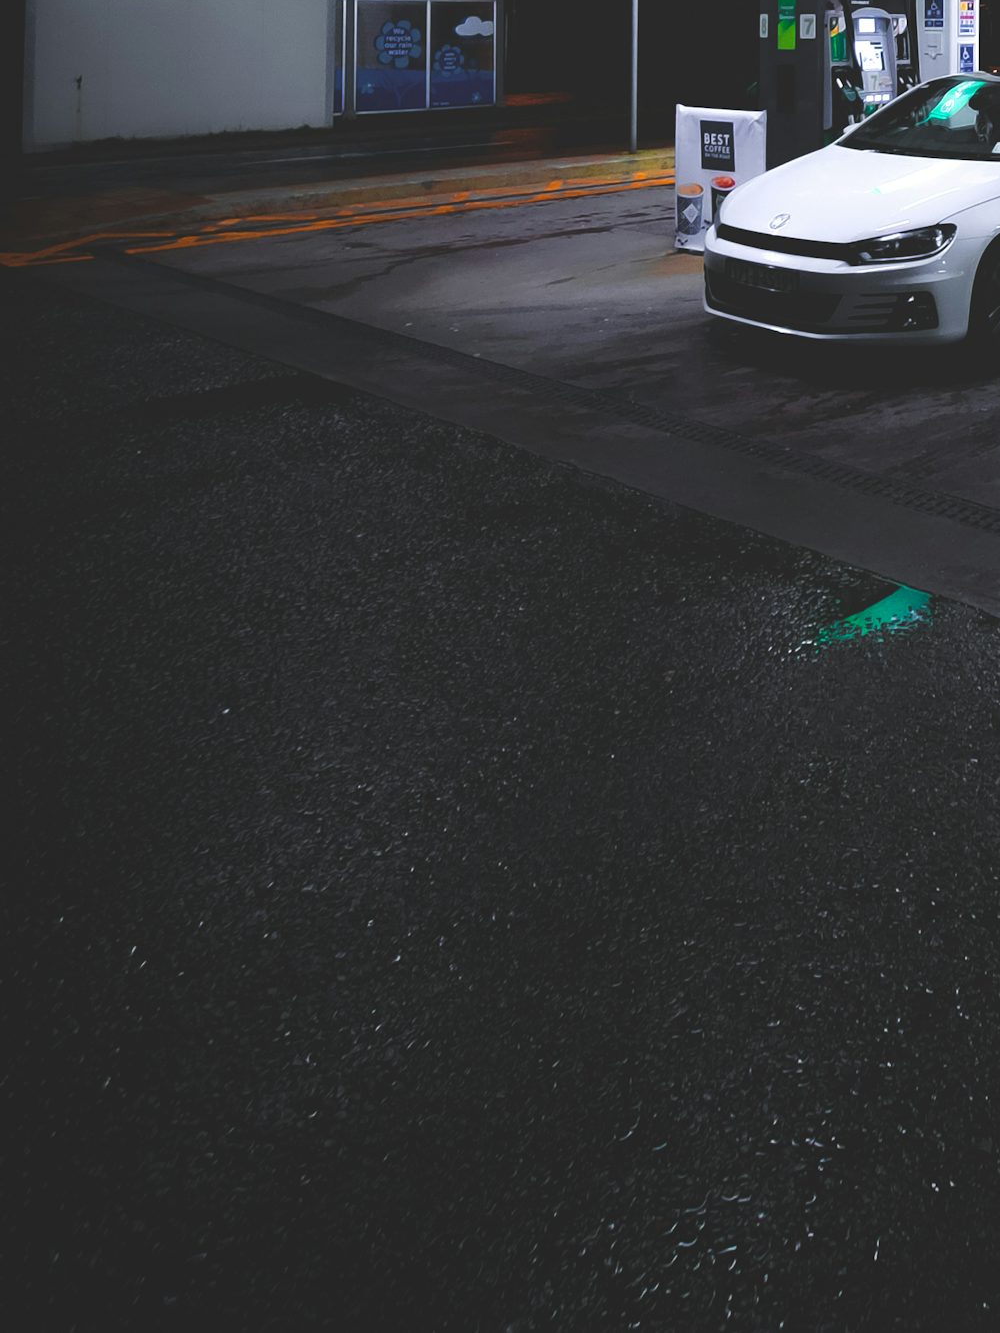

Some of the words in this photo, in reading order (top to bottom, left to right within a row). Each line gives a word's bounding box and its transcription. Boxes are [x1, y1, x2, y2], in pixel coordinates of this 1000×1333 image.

[804, 19, 814, 35] 7
[871, 75, 878, 91] 7
[704, 133, 730, 146] BEST
[704, 145, 731, 154] COFFEE
